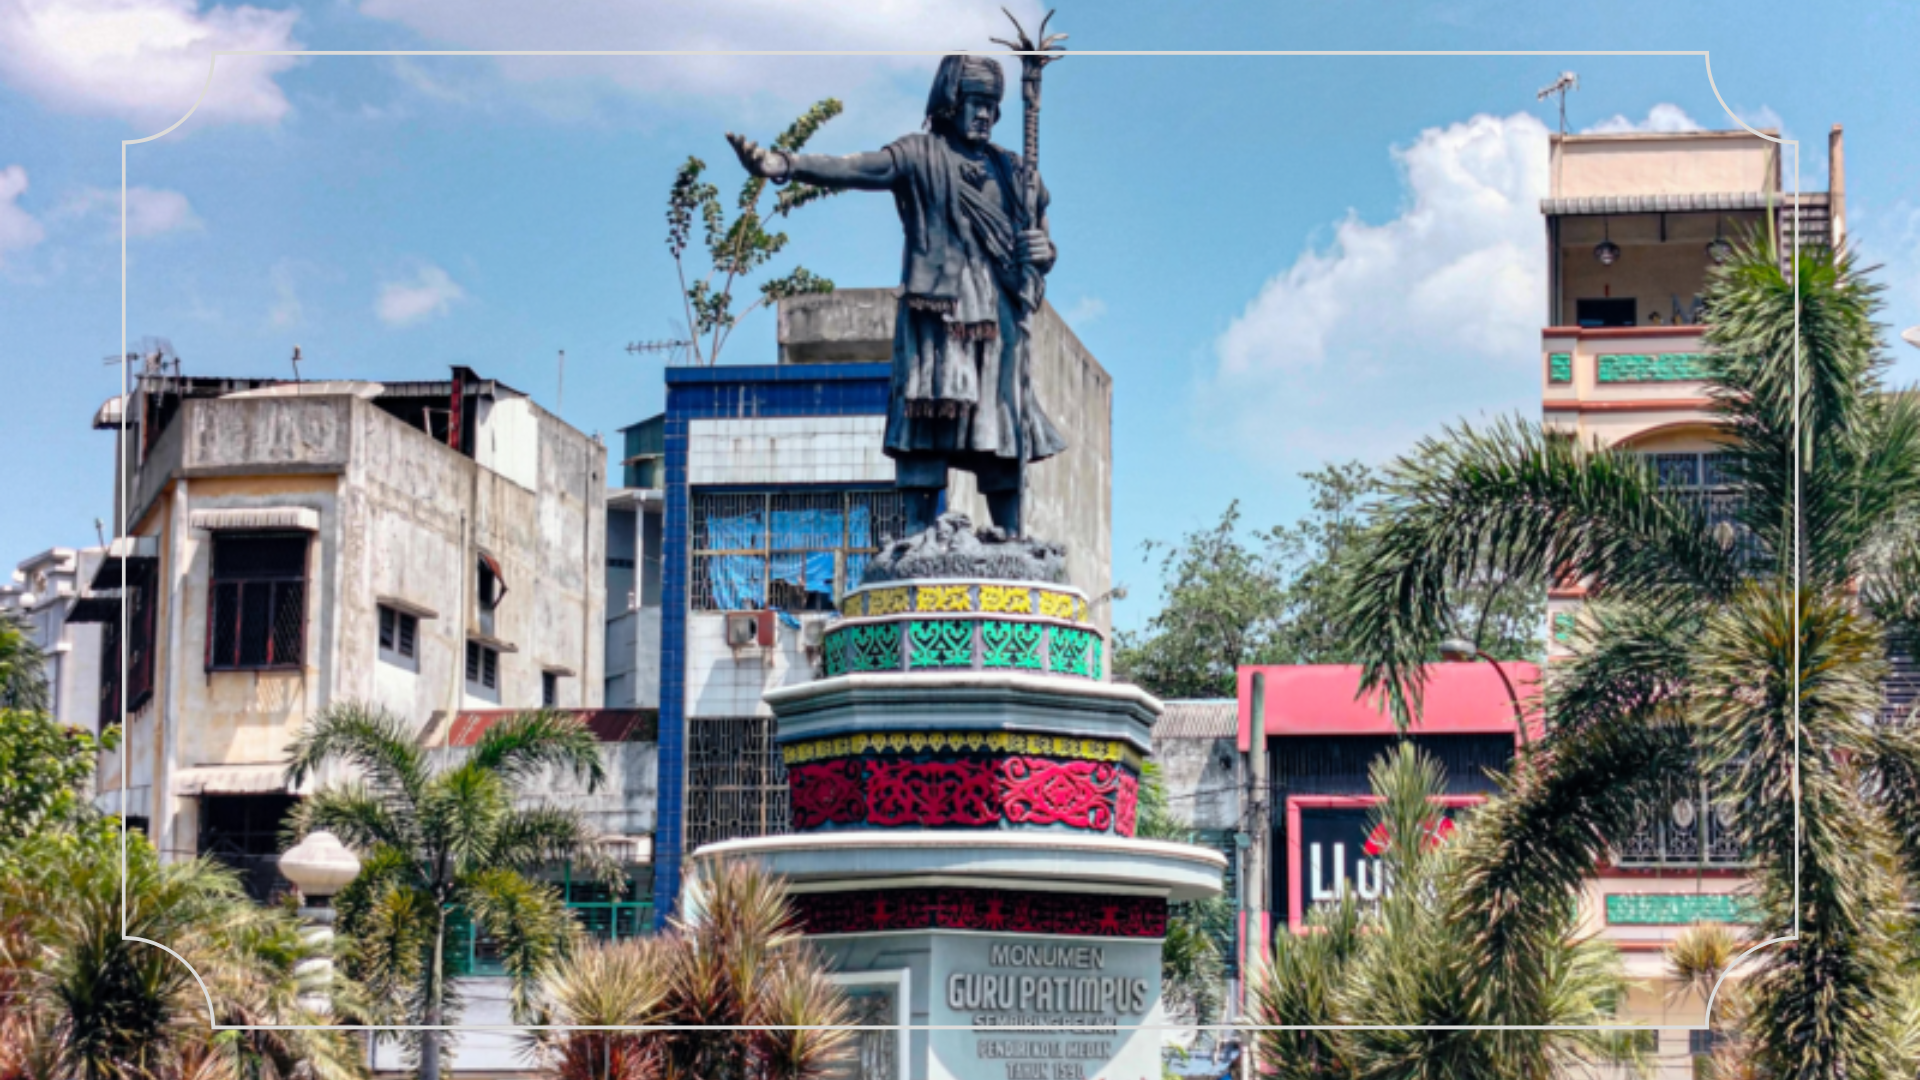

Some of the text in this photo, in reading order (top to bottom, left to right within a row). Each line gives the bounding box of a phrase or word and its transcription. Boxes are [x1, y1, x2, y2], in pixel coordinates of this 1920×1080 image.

[991, 944, 1105, 969] MONUMEN
[948, 973, 1148, 1014] GURU PATIMPUS
